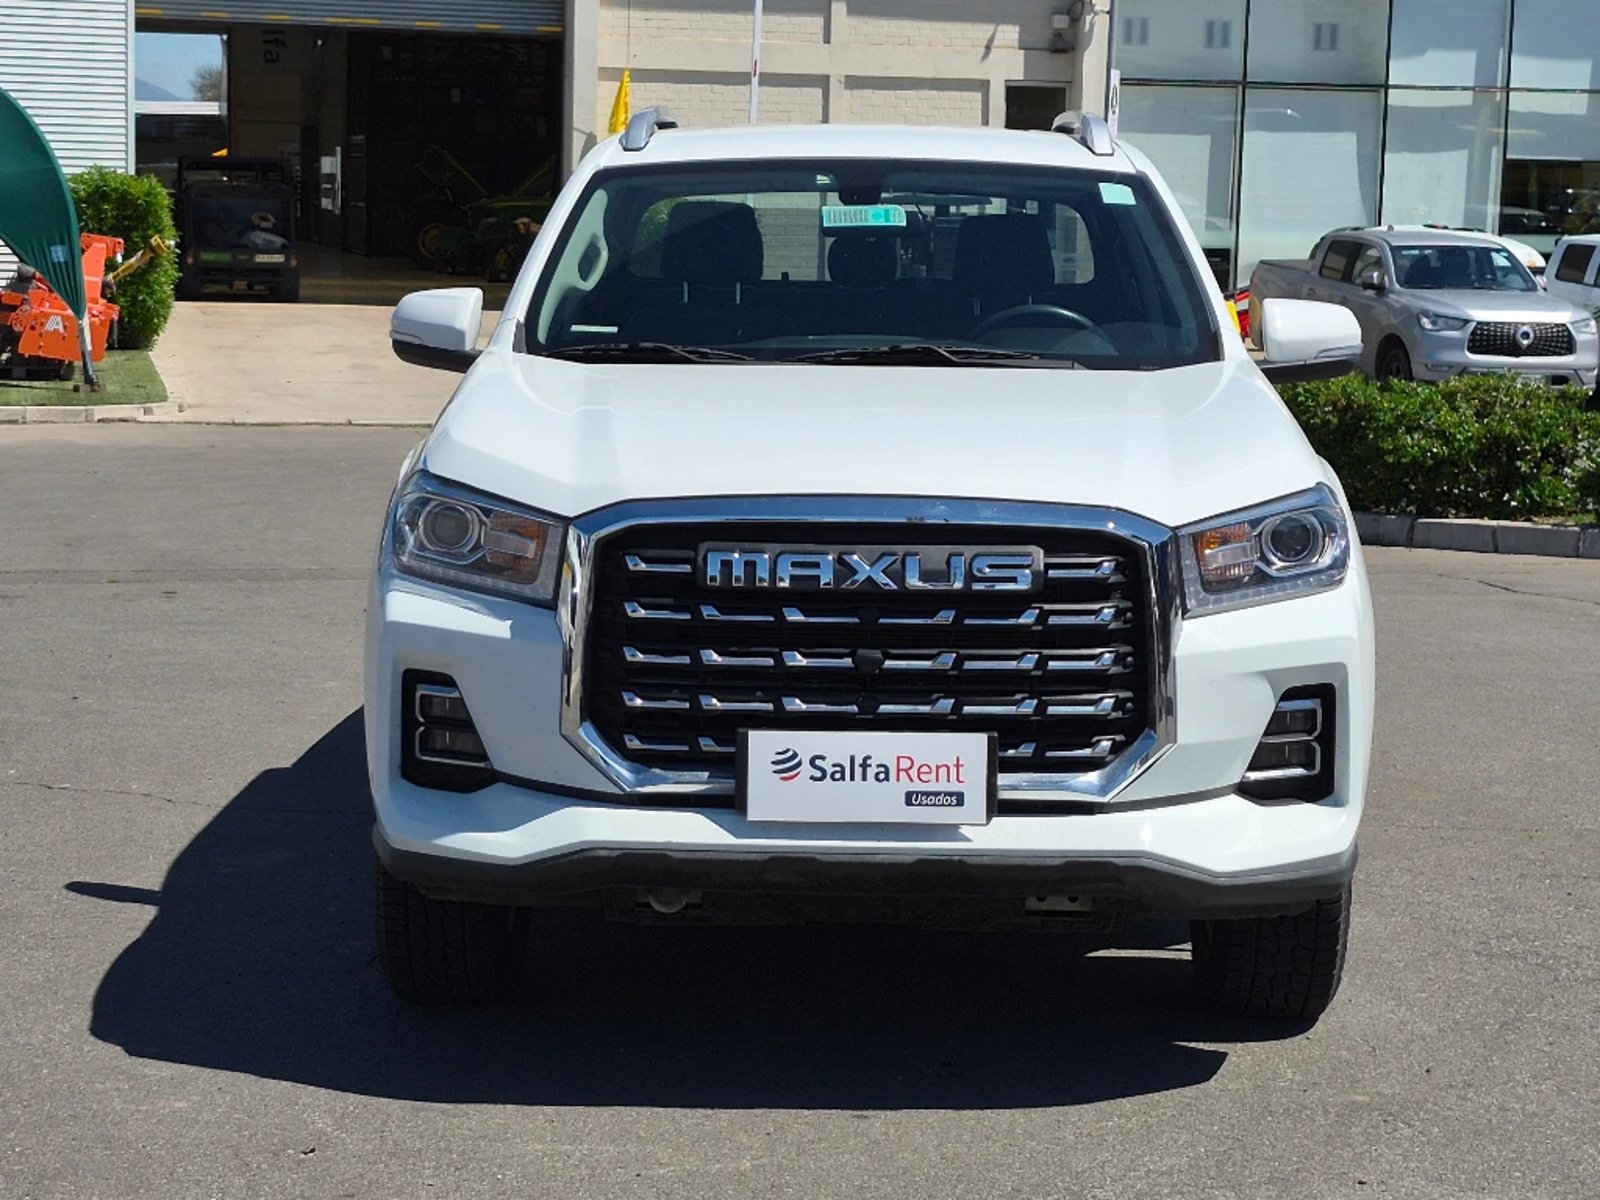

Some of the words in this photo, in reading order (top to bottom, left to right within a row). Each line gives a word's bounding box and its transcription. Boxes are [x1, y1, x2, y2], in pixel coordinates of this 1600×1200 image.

[706, 551, 1034, 590] MAXUS
[808, 754, 965, 784] SalfaRent
[911, 793, 957, 806] Usados
